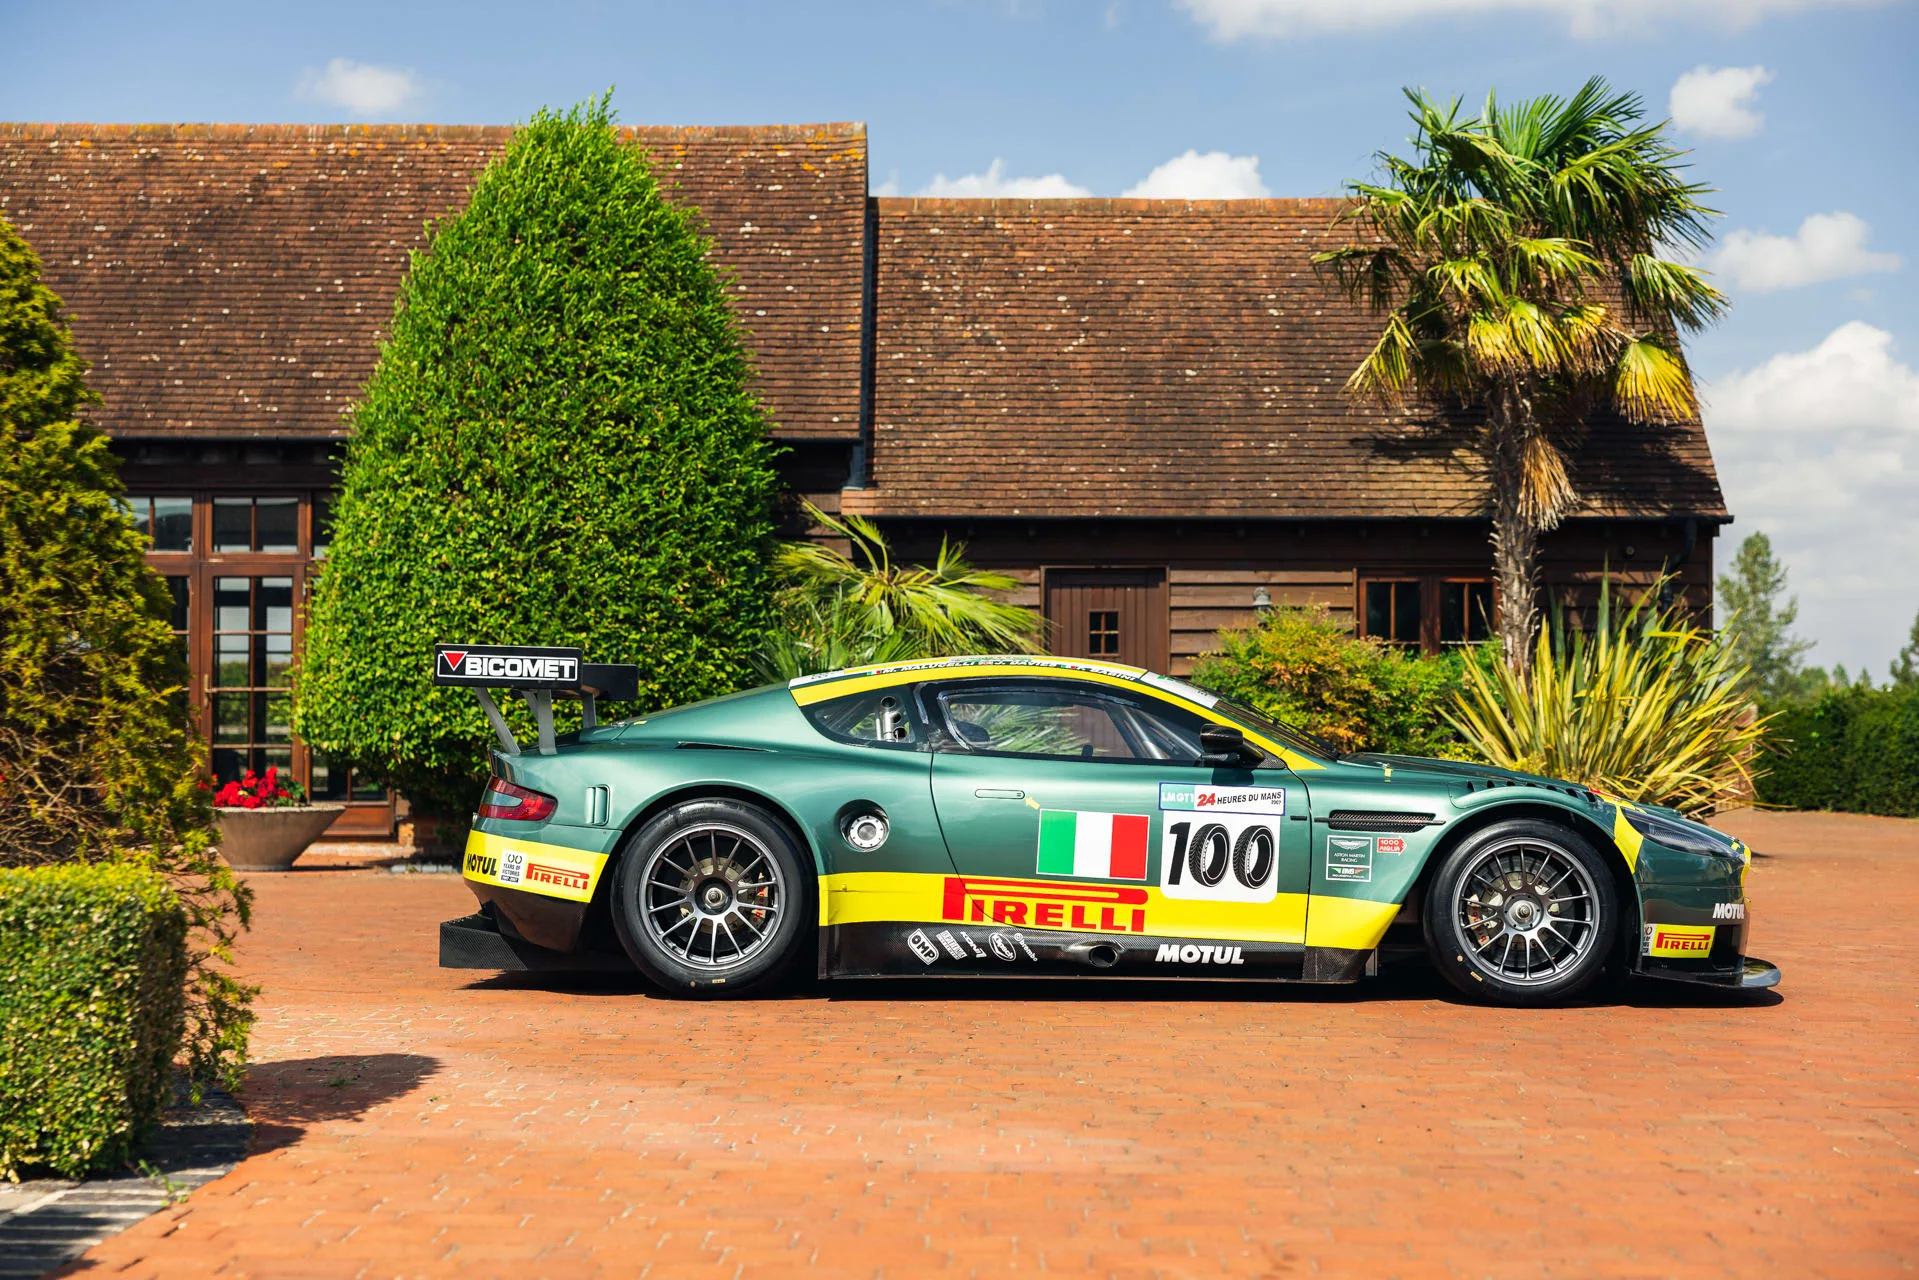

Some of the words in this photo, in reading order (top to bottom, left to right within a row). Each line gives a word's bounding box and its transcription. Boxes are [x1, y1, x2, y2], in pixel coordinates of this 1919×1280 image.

[465, 657, 575, 678] BICOMET
[1197, 793, 1216, 807] 24
[1217, 794, 1247, 805] HEURES
[1248, 793, 1259, 802] DU
[1260, 791, 1282, 801] MANS
[466, 853, 497, 876] MOTUL
[1168, 822, 1275, 889] 100
[526, 863, 590, 890] PIRELLI
[942, 877, 1148, 932] PIRELLI
[911, 935, 936, 959] OMP
[992, 932, 1014, 960] Klipsch
[1019, 940, 1038, 961] brembo
[1656, 932, 1711, 950] PIRELLI
[1155, 944, 1245, 965] MOTUL
